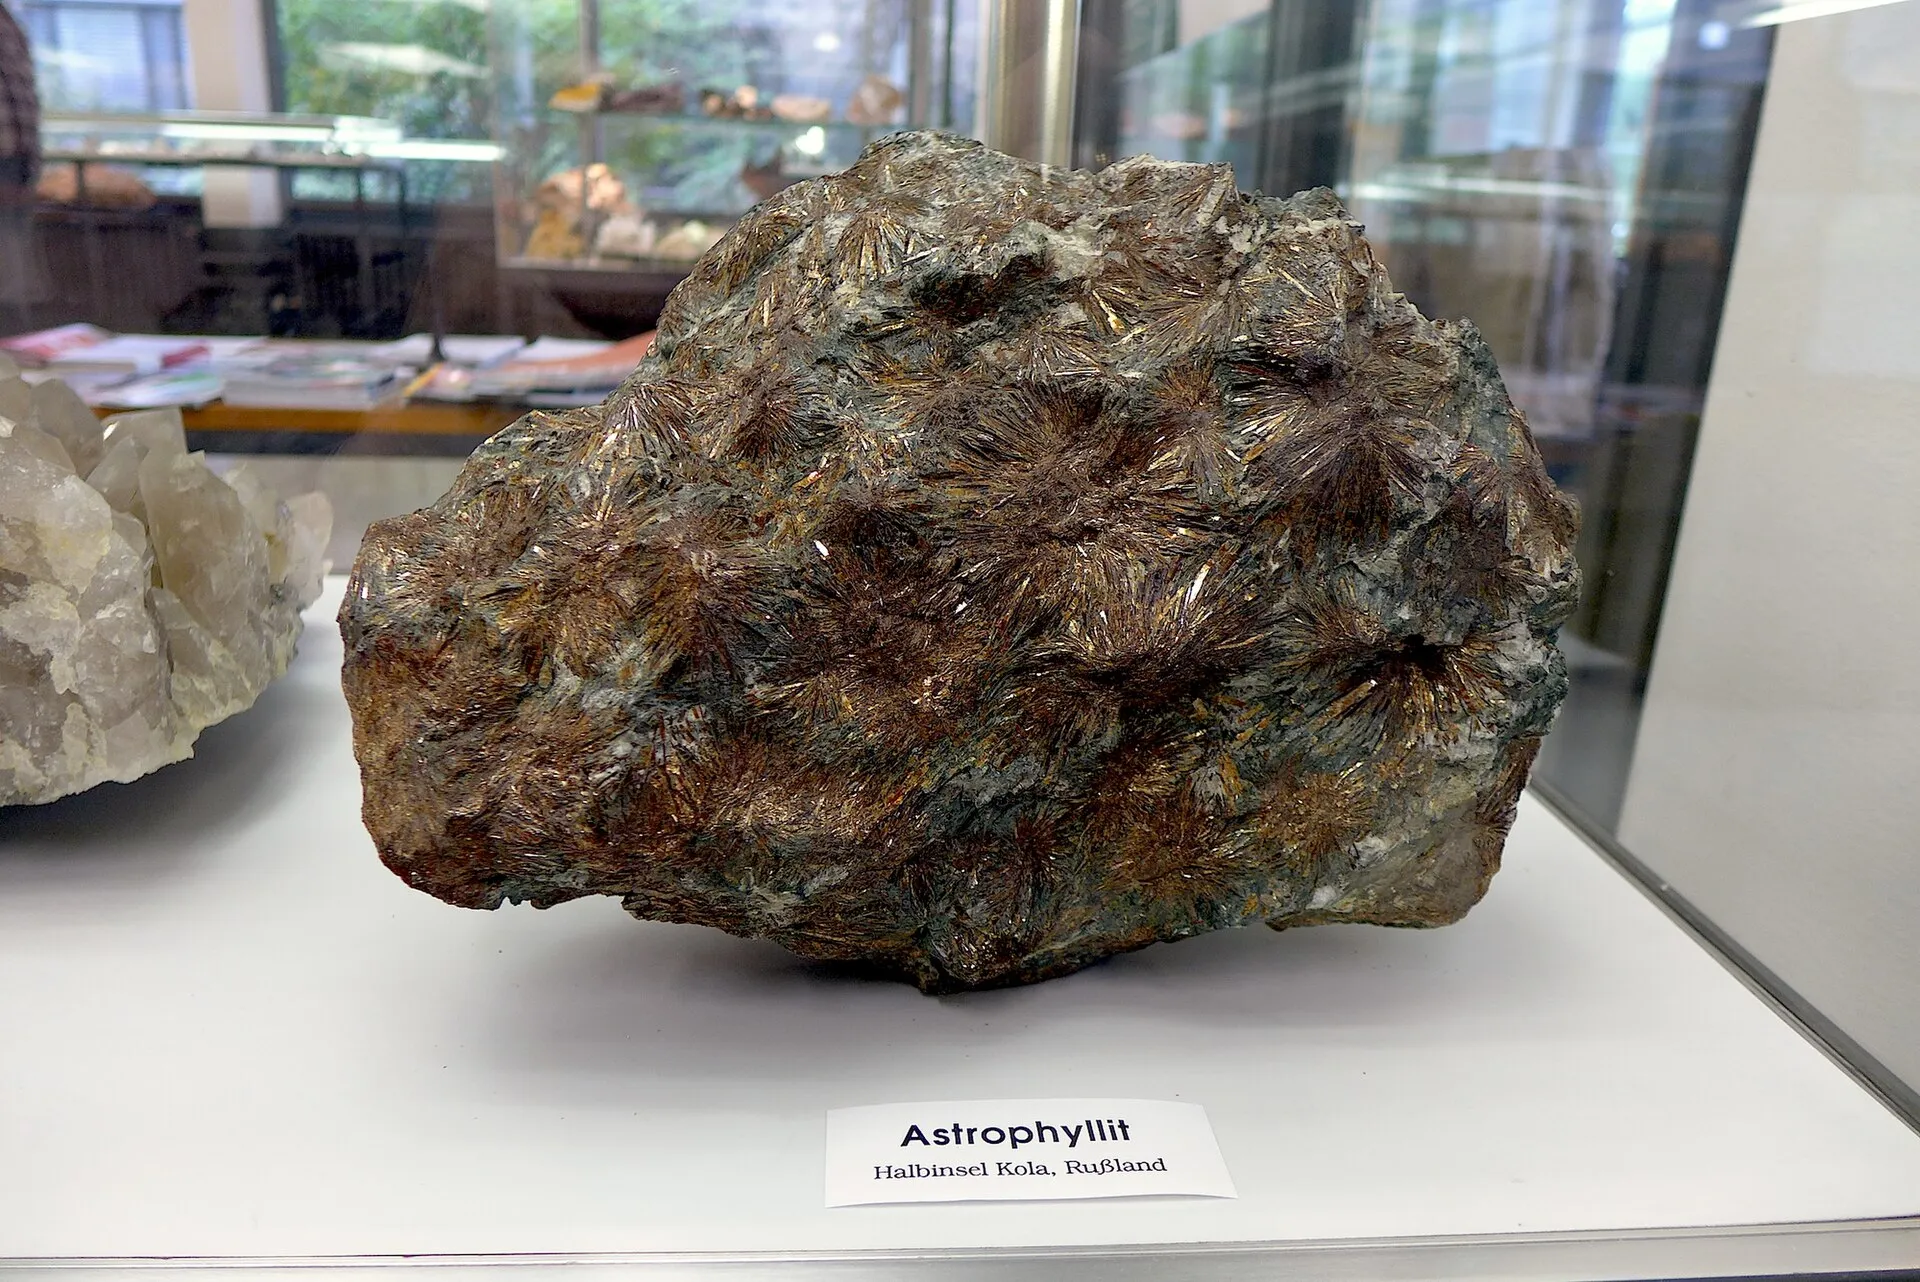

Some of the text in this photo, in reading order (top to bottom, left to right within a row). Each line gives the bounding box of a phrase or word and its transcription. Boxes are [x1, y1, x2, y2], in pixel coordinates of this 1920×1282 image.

[901, 1119, 1130, 1148] Astrophyllit
[874, 1158, 1168, 1180] Halbinsel Kola, Rußland
